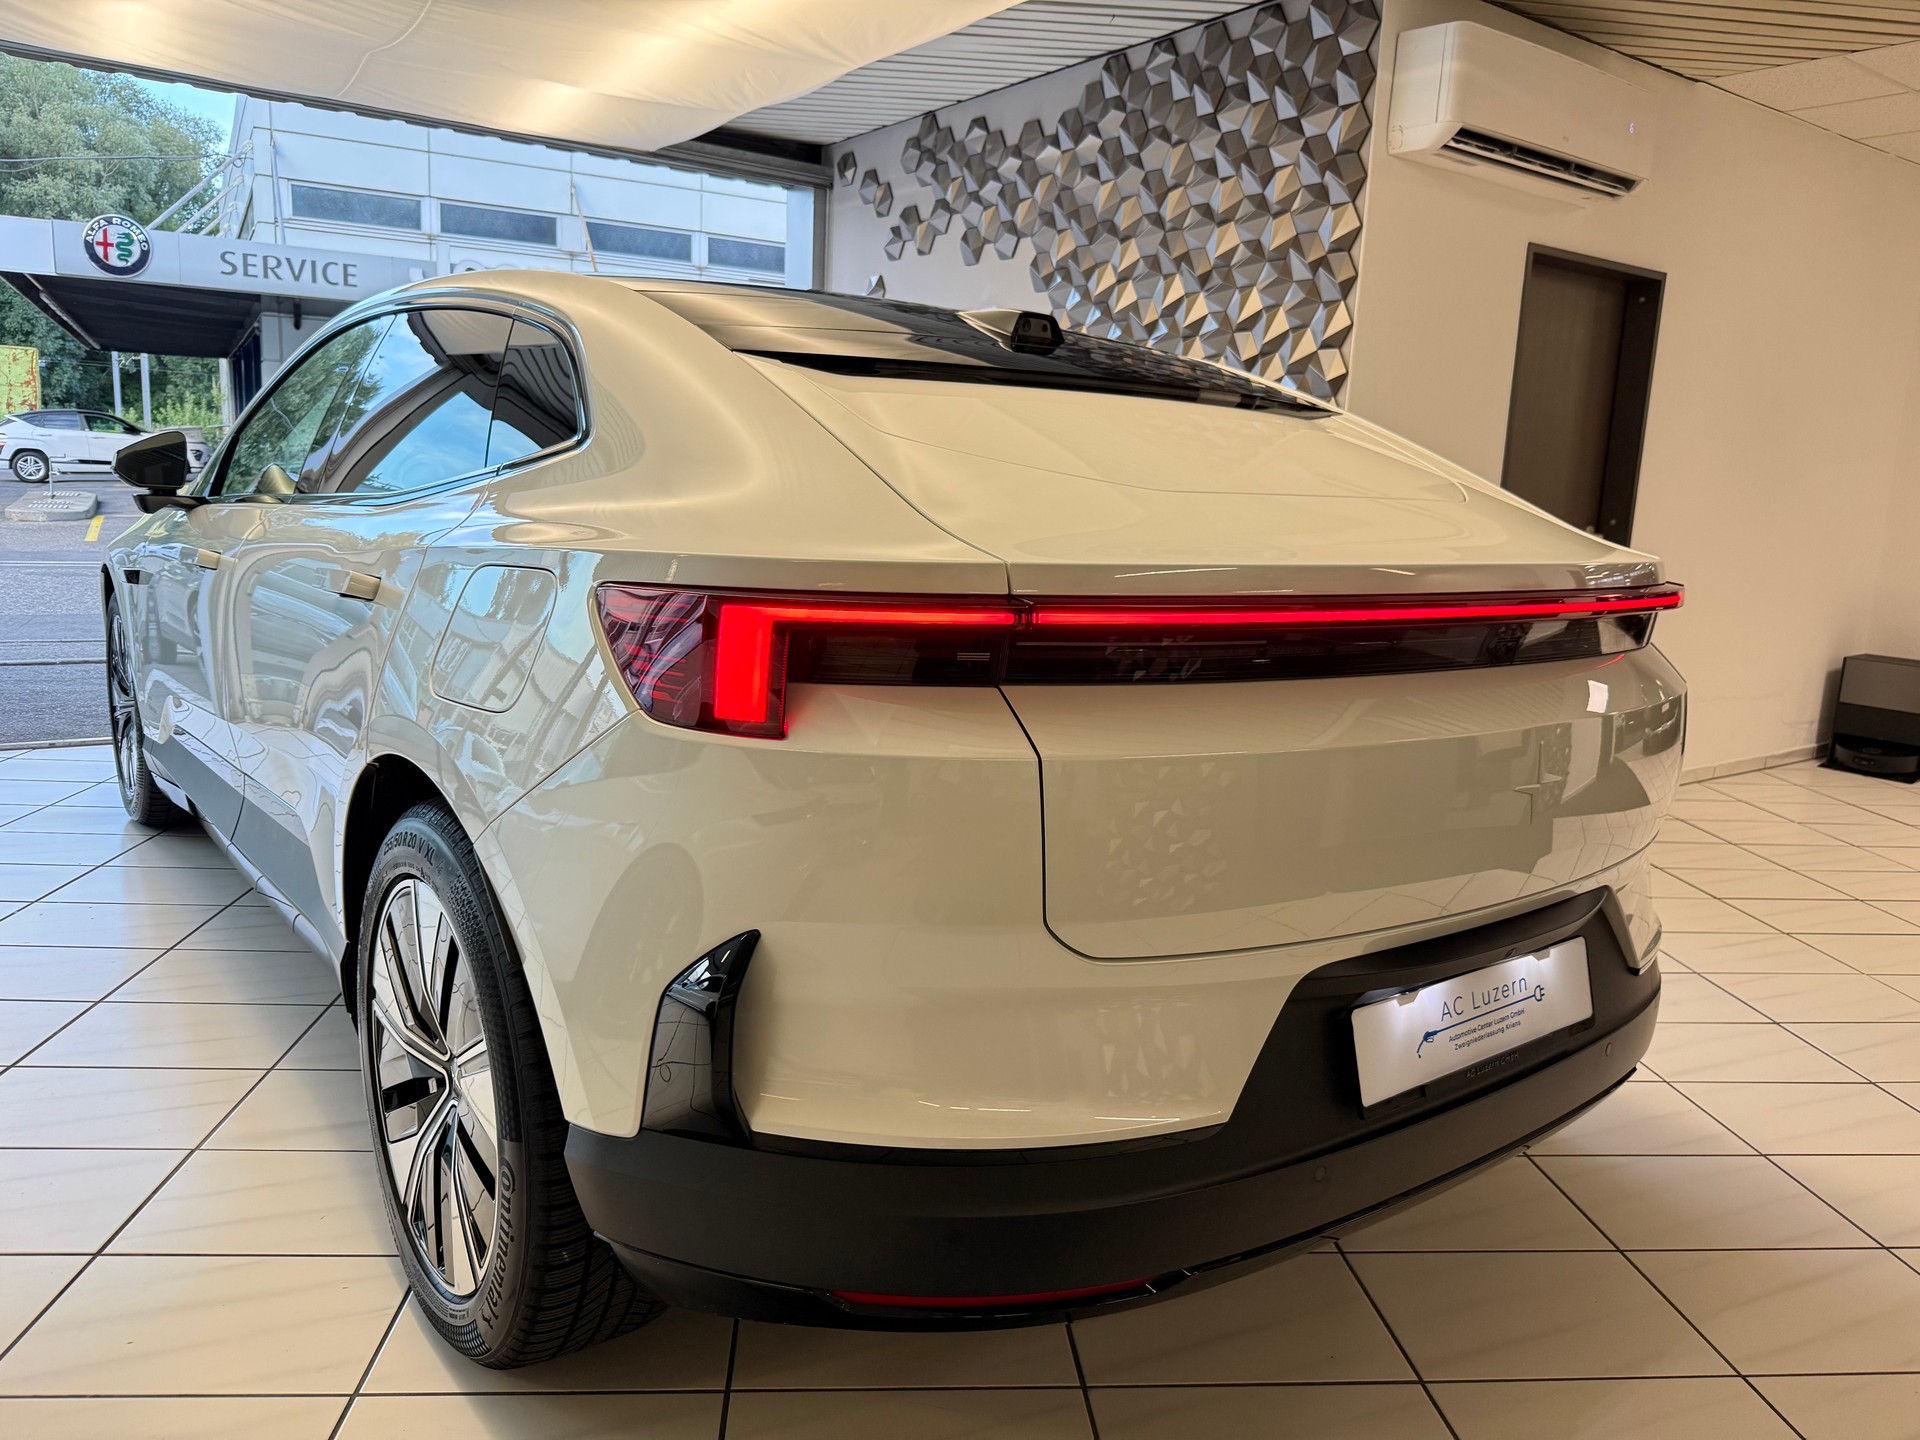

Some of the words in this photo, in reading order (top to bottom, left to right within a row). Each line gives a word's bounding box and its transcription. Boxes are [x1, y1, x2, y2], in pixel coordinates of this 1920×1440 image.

[86, 219, 109, 243] ALFA
[112, 217, 148, 251] ROMEO
[220, 250, 358, 288] SERVICE
[424, 843, 435, 866] XL
[1441, 996, 1464, 1021] AC
[1472, 978, 1527, 1009] Luzern
[1449, 1027, 1477, 1042] Automotive
[1477, 1020, 1493, 1032] Center
[1494, 1014, 1510, 1026] Luzern
[1510, 1007, 1525, 1019] GmbH
[1505, 1020, 1521, 1031] Kriens
[484, 1157, 516, 1321] Continental
